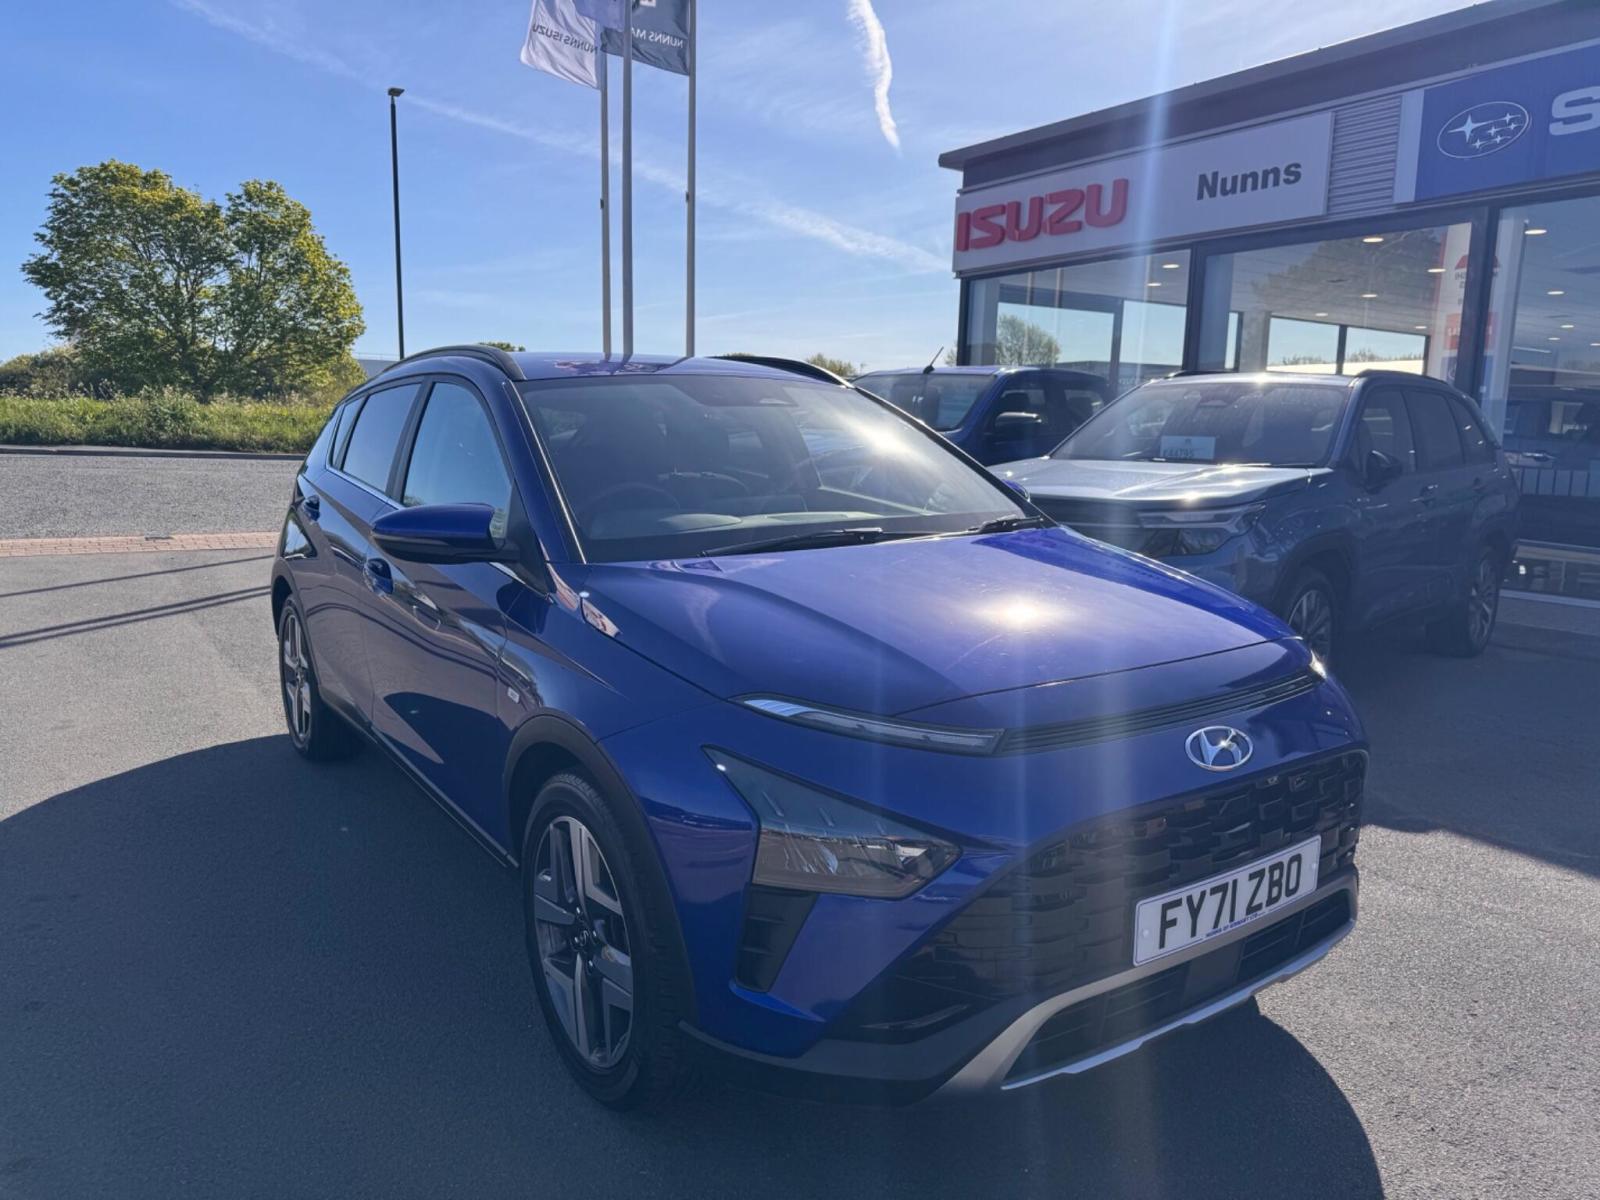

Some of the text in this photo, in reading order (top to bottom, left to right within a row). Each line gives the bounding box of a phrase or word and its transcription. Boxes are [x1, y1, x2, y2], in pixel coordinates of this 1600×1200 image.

[956, 178, 1129, 252] ISUZU
[1197, 162, 1302, 200] Nunns
[1158, 853, 1303, 950] FY71 ZBO
